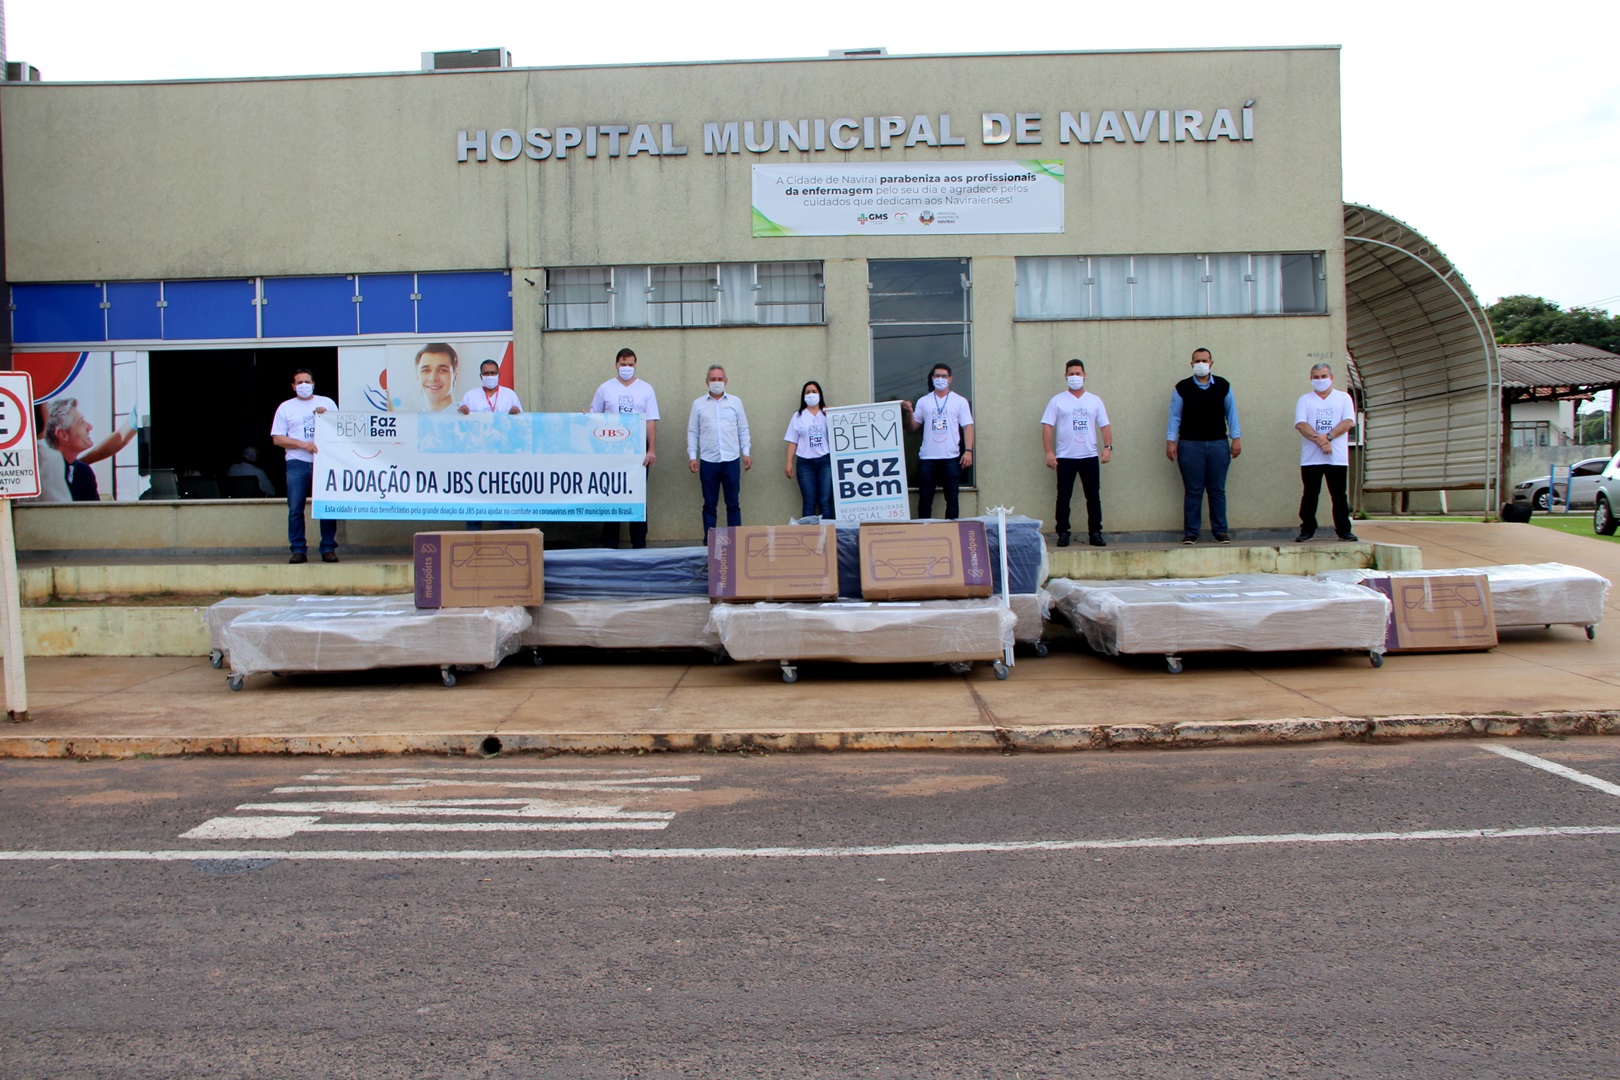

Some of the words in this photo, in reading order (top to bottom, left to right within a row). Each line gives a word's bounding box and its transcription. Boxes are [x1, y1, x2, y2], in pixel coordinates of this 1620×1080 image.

[457, 123, 688, 162] HOSPITAL
[704, 112, 966, 155] MUNICIPAL
[982, 111, 1042, 145] DE
[1060, 100, 1256, 144] NAVIRAÍ
[776, 176, 785, 185] A
[786, 175, 825, 185] Cidade
[825, 175, 839, 185] de
[841, 174, 878, 184] Naviraí
[879, 174, 941, 185] parabeniza
[943, 174, 963, 183] aos
[966, 172, 1037, 184] profissionais
[785, 187, 799, 196] da
[802, 186, 873, 197] enfermagem
[876, 185, 899, 196] pelo
[900, 186, 919, 194] seu
[921, 185, 938, 194] dia
[949, 184, 998, 196] agradece
[1000, 184, 1029, 195] pelos
[803, 197, 851, 207] cuidados
[853, 198, 874, 207] que
[876, 196, 922, 206] dedicam
[924, 197, 943, 205] aos
[945, 195, 1013, 205] Naviraienses!
[868, 213, 889, 221] GMS
[370, 415, 397, 428] Faz
[832, 411, 876, 426] FAZER
[882, 409, 896, 421] O
[336, 422, 367, 437] BEM
[370, 427, 397, 437] Bem
[598, 429, 625, 437] JBS
[833, 421, 899, 452] BEM
[0, 452, 20, 467] XI
[837, 456, 900, 481] Faz
[325, 469, 337, 492] A
[343, 465, 411, 499] DOAÇÃO
[416, 471, 439, 493] DA
[443, 471, 474, 494] JBS
[478, 471, 544, 495] CHEGOU
[550, 471, 583, 495] POR
[588, 471, 633, 497] AQUI.
[839, 479, 902, 500] Bem
[325, 505, 336, 513] Esta
[336, 505, 353, 513] cidade
[379, 505, 410, 514] beneficiadas
[410, 506, 421, 515] pela
[422, 507, 439, 516] grande
[440, 507, 457, 516] doação
[465, 507, 475, 515] JBS
[476, 508, 487, 516] para
[487, 507, 503, 516] ajudar
[510, 507, 532, 515] combate
[576, 507, 584, 515] 197
[584, 507, 611, 516] municípios
[611, 507, 618, 515] do
[618, 507, 633, 515] Brasil.
[840, 503, 905, 514] RESPONSABILIDADE
[842, 511, 882, 522] SOCIAL
[888, 509, 905, 518] JBS
[424, 556, 433, 598] medparts
